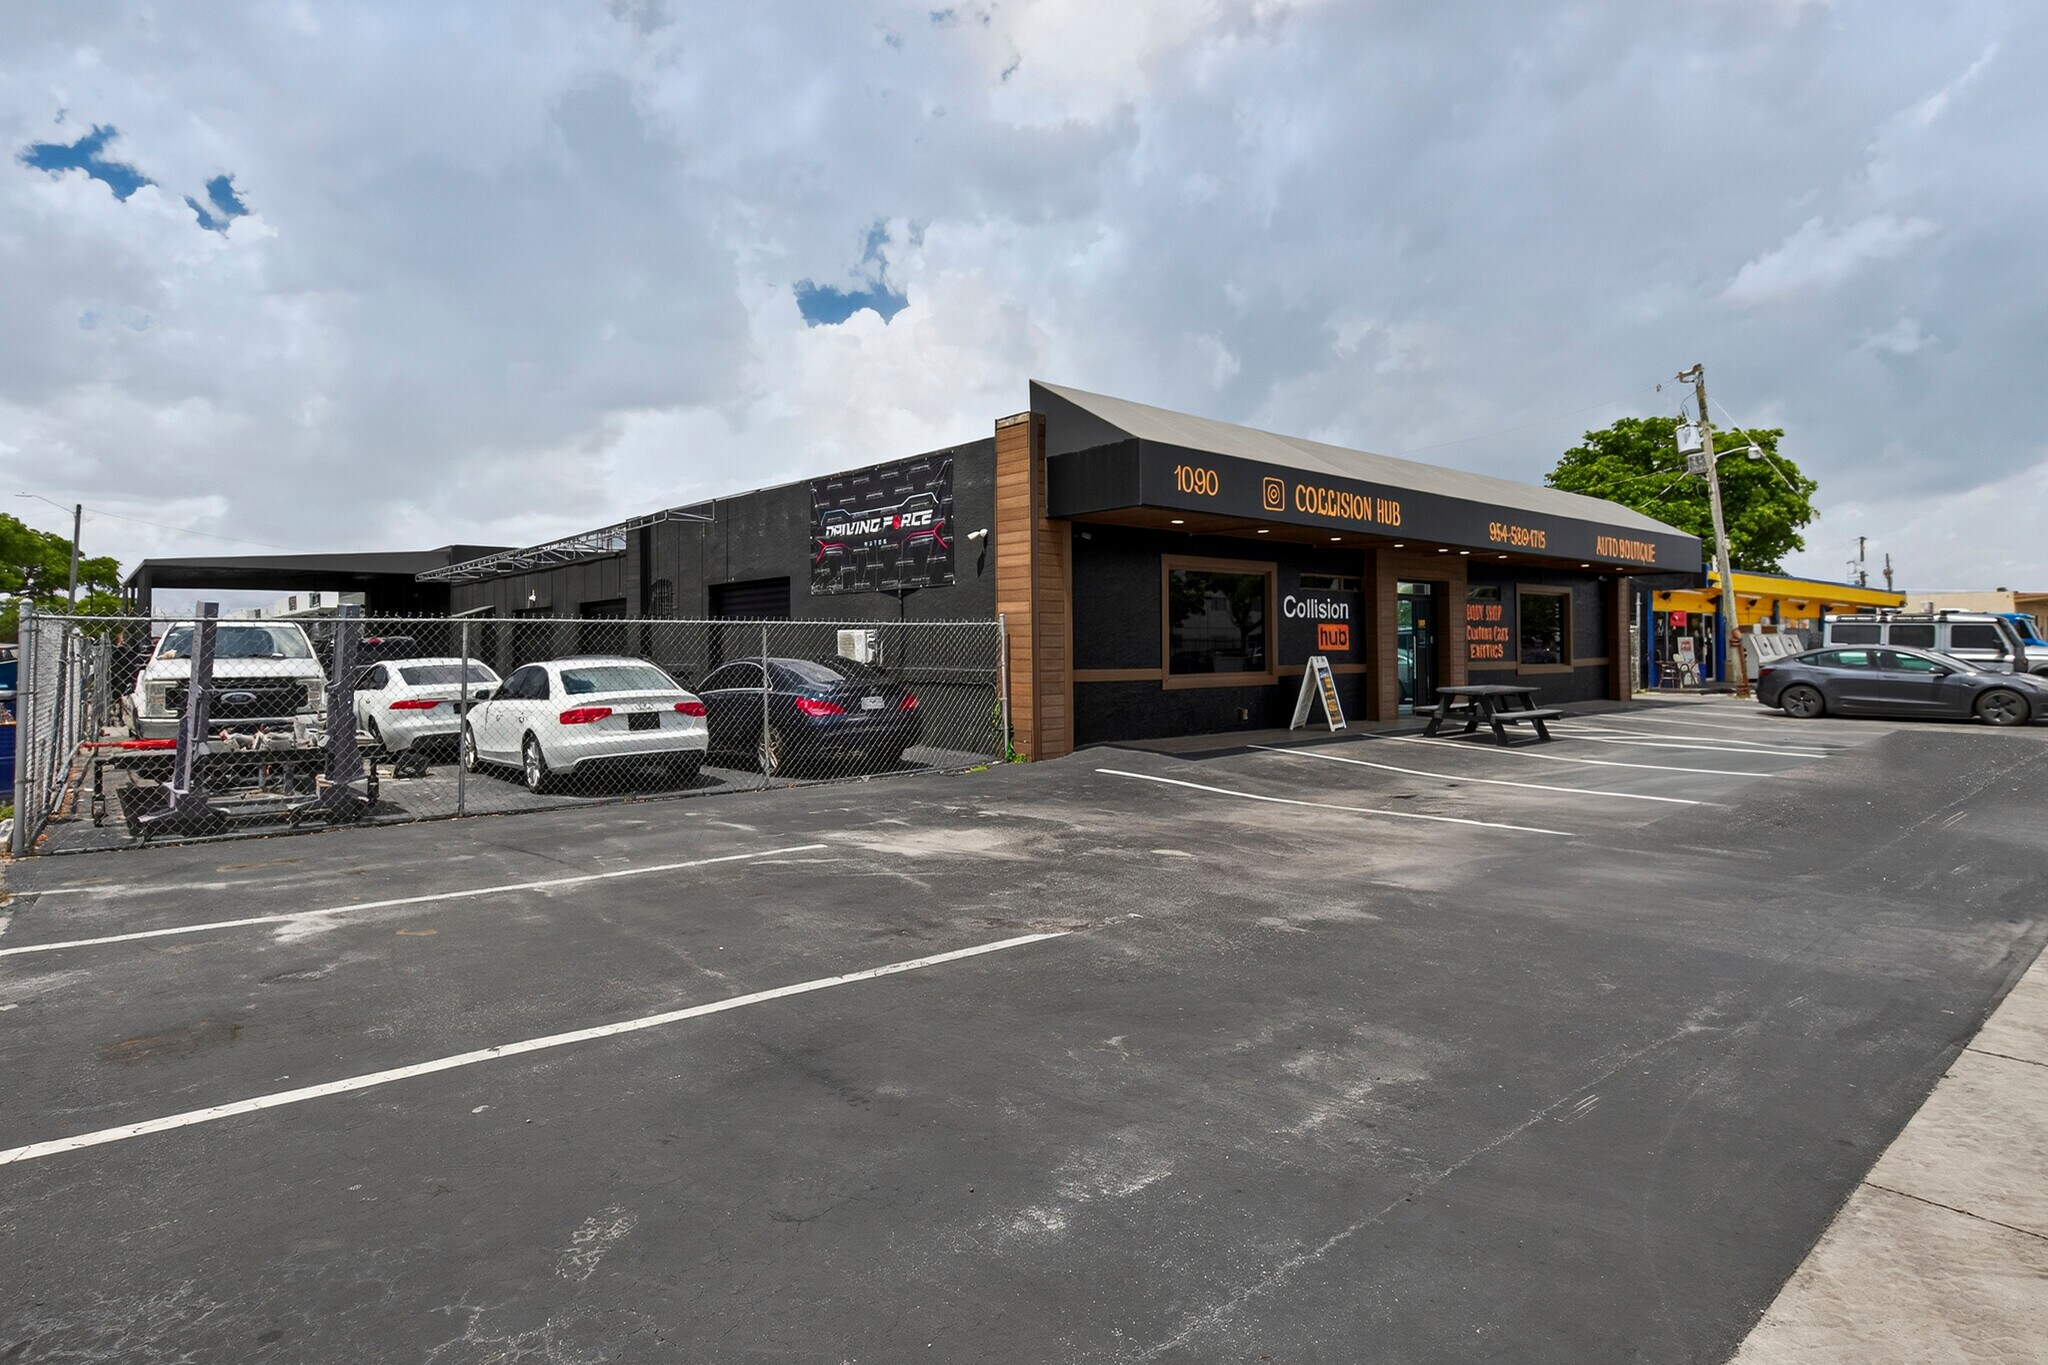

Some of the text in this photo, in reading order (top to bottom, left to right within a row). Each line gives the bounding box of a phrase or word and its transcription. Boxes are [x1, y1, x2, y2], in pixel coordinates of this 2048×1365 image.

[1174, 465, 1219, 496] 1090
[1295, 484, 1401, 526] COLLISION HUB
[825, 518, 881, 537] DRIVING
[1596, 535, 1656, 565] AUTO BOUTIQUE
[1283, 595, 1349, 620] Collision
[1485, 604, 1502, 621] SHOP
[1320, 627, 1347, 646] hub
